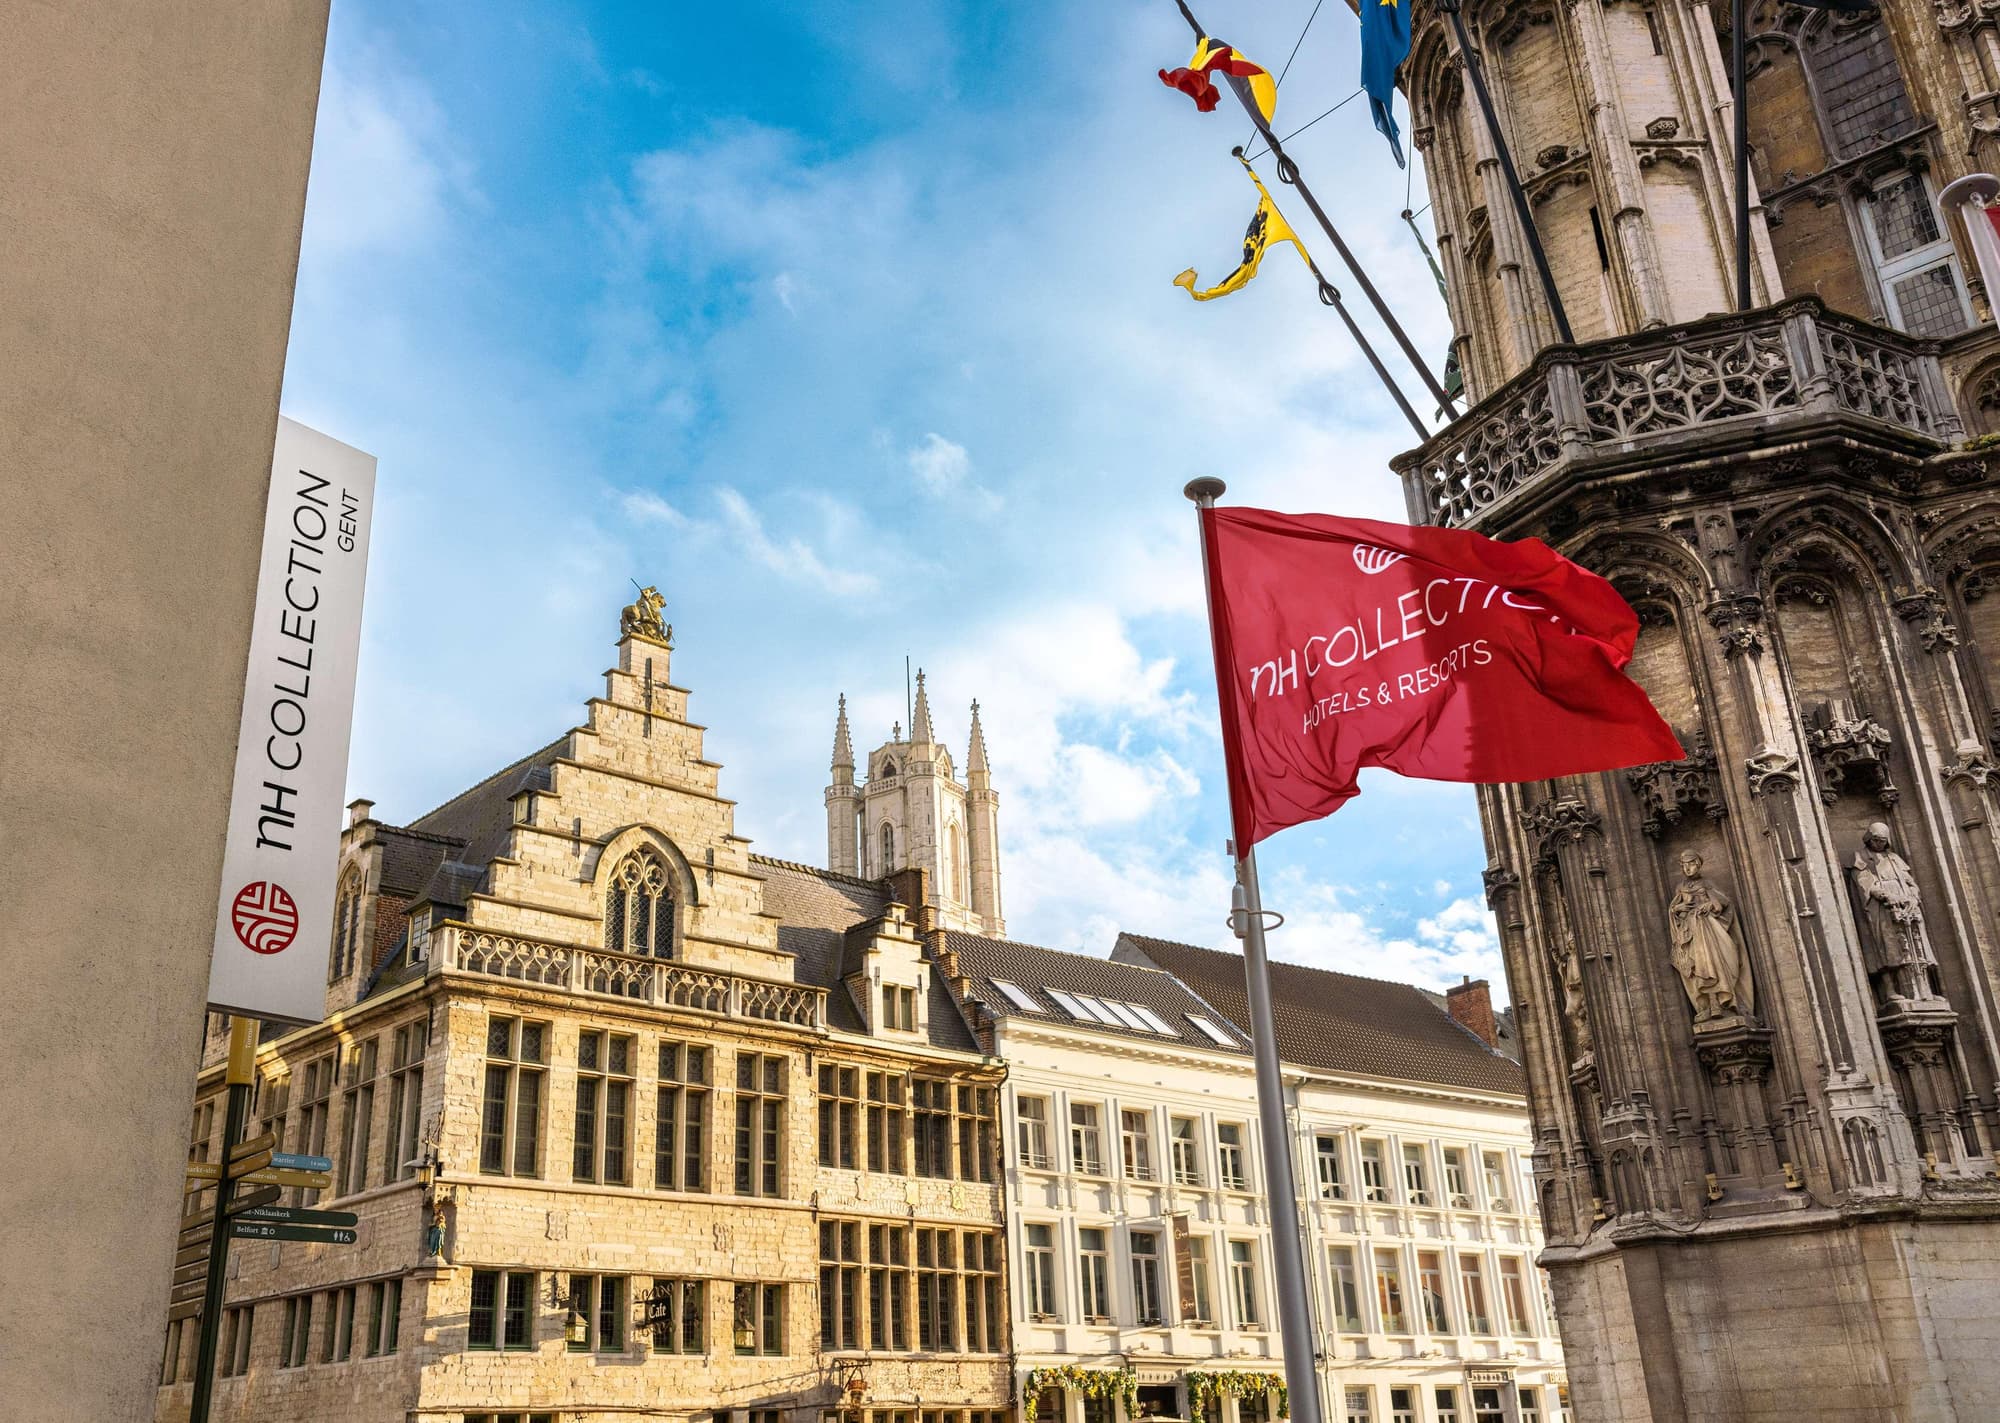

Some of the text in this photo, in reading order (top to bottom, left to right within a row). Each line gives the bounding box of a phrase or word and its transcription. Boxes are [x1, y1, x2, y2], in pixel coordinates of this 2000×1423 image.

[337, 489, 359, 552] GENT
[267, 470, 331, 770] COLLECTION
[1303, 639, 1493, 734] HOTELS & RESORTS
[236, 1225, 259, 1233] Belfort
